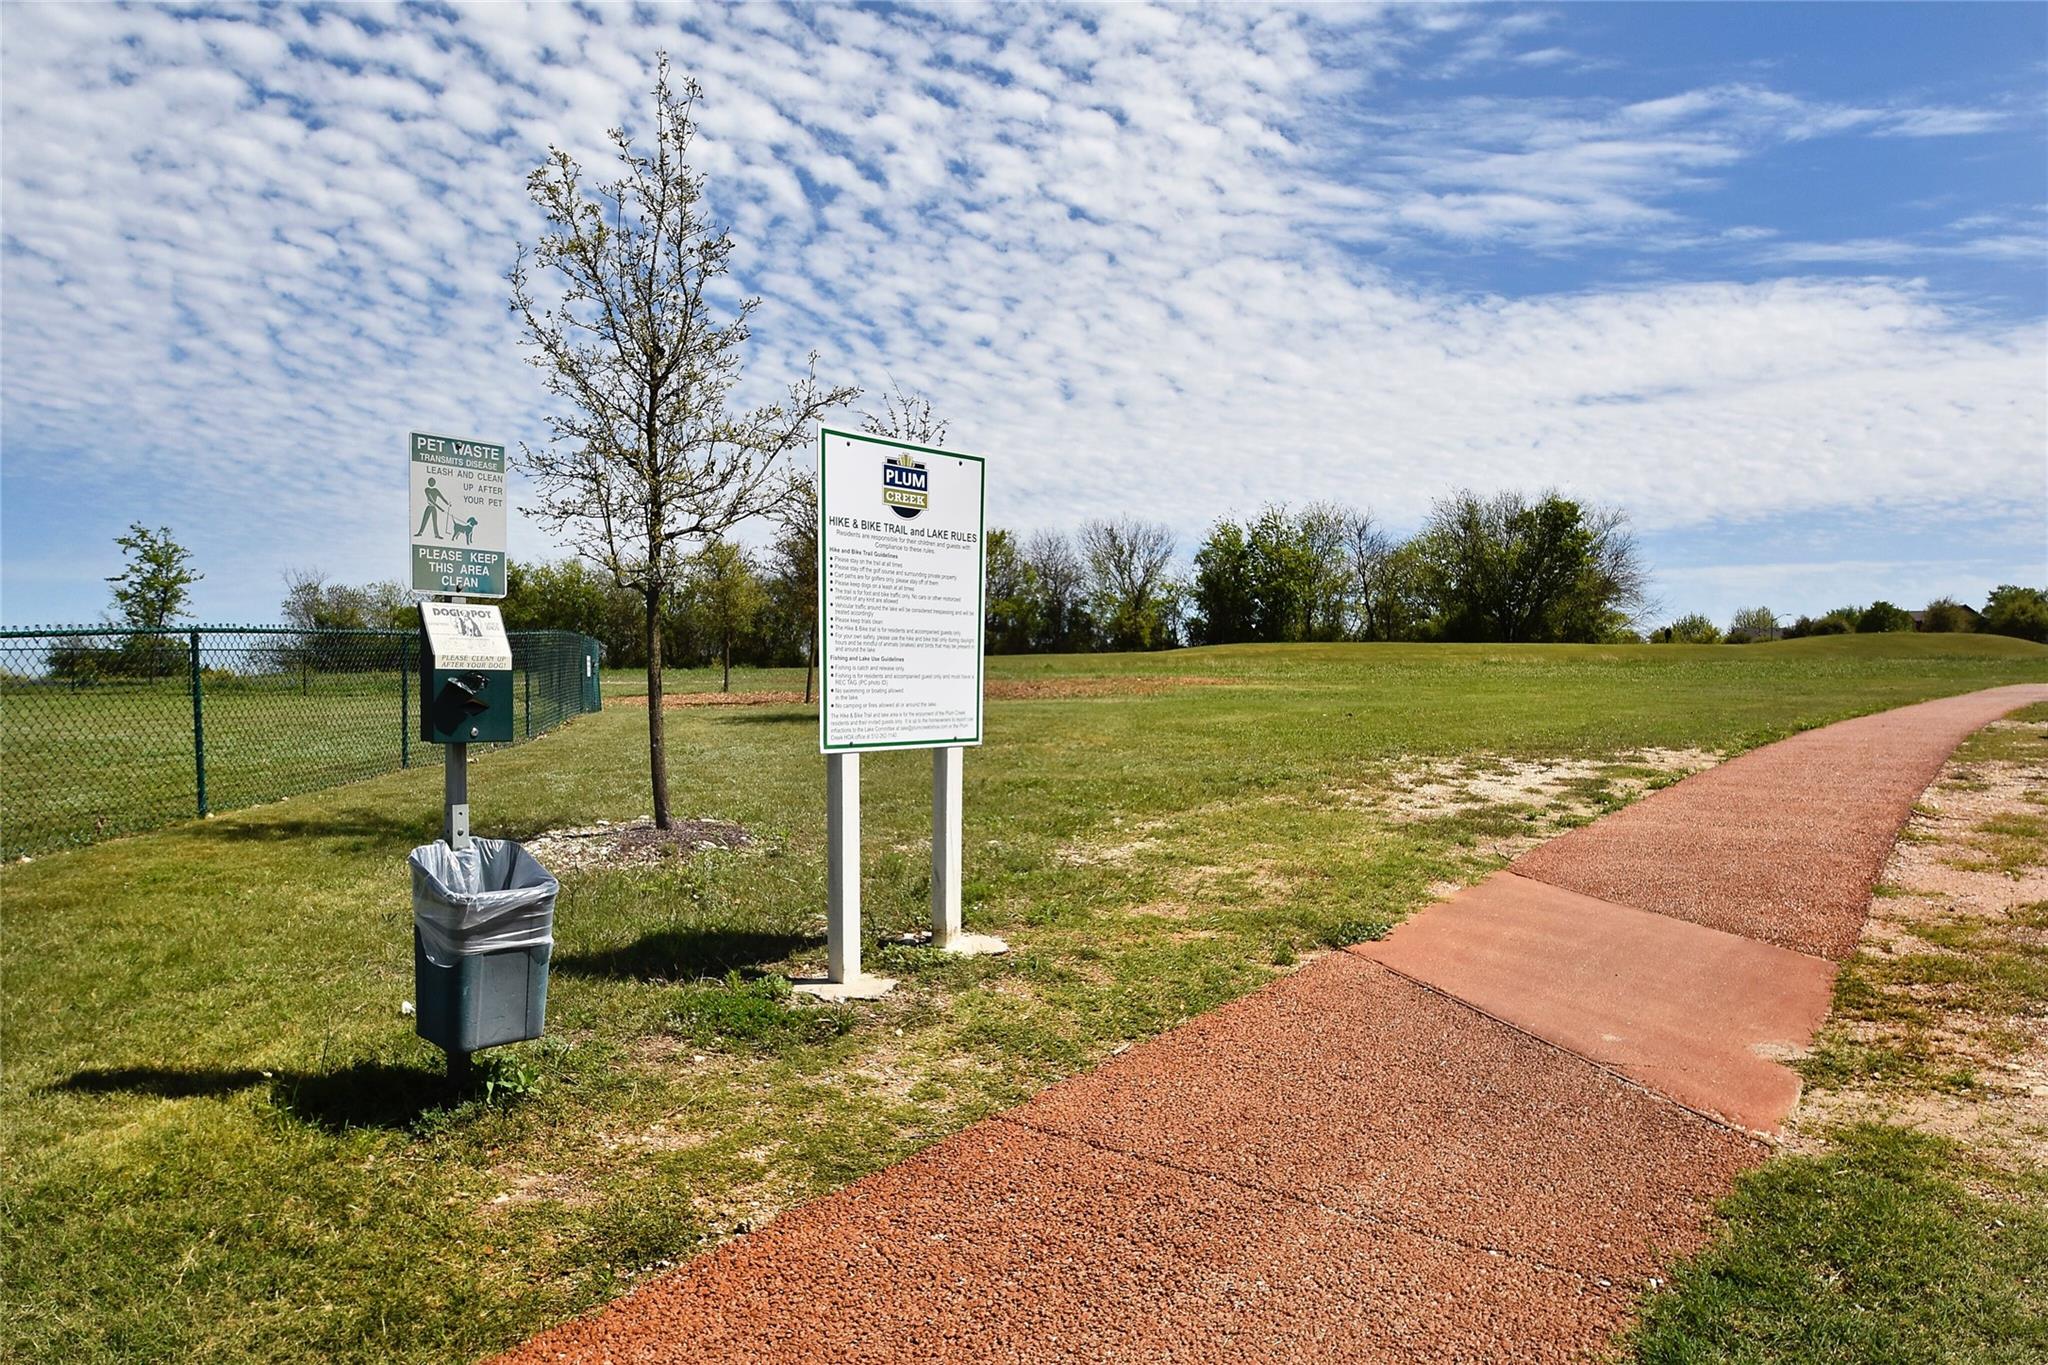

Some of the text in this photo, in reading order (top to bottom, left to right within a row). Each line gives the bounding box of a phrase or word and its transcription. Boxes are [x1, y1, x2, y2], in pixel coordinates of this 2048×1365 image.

[418, 437, 500, 460] PET WASTE
[420, 453, 497, 470] TRANSMITS DISEASE
[427, 466, 503, 483] LEASH AND CLEAN
[886, 469, 925, 488] PLUM
[478, 485, 503, 495] AFTER
[464, 496, 503, 507] YOUR PET
[886, 491, 925, 506] CREEK
[829, 516, 977, 543] HIKE & BIKE TRAIL and LAKE RULES
[419, 548, 498, 564] PLEASE KEEP
[429, 562, 490, 576] THIS AREA
[441, 576, 478, 588] CLEAN
